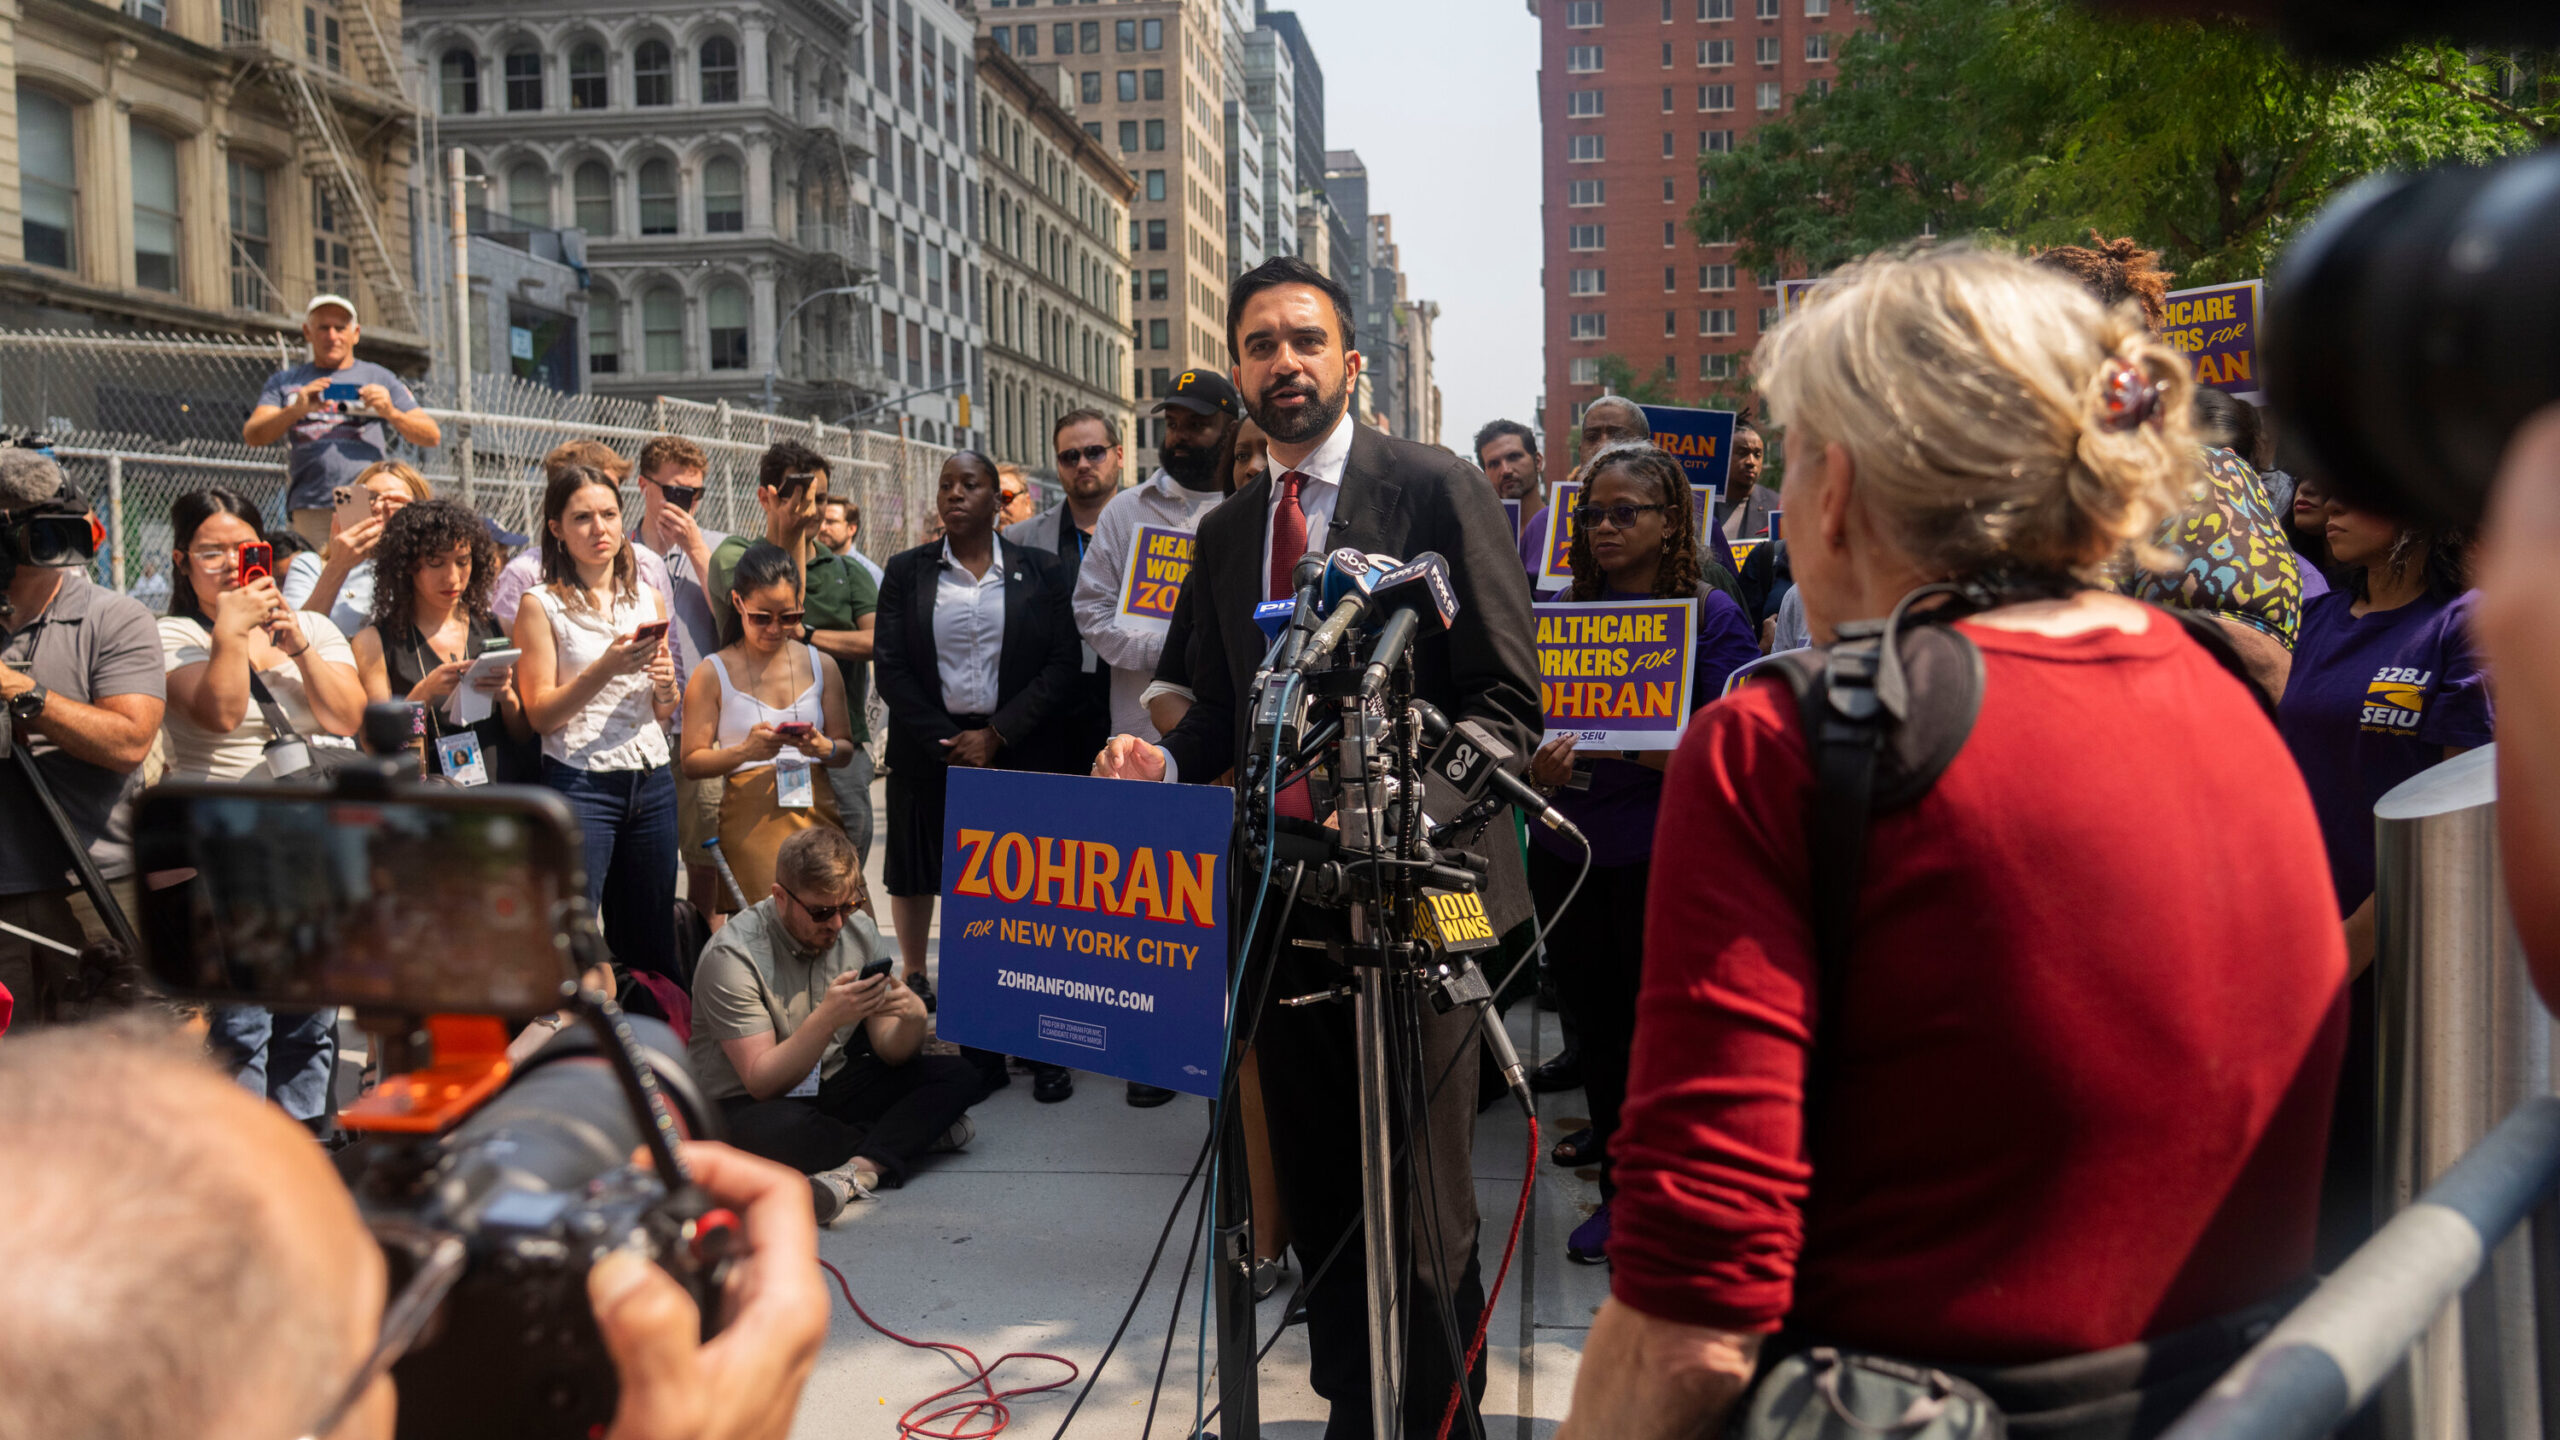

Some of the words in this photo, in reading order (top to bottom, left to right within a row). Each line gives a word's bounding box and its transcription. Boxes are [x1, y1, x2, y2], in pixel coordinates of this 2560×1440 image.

[2162, 295, 2236, 328] HCARE
[2207, 323, 2247, 348] FOR
[1177, 372, 1196, 391] P
[1653, 432, 1717, 457] RAN
[1684, 460, 1709, 469] CITY
[1337, 550, 1370, 573] abc
[1534, 614, 1668, 643] ALTHCARE
[1538, 648, 1629, 677] RKERS
[1631, 648, 1677, 673] FOR
[2372, 667, 2432, 685] 32BJ
[1541, 681, 1676, 718] HRAN
[2359, 707, 2421, 728] SEIU
[1456, 744, 1480, 768] 2
[953, 828, 1219, 928] ZOHRAN
[1429, 891, 1484, 921] 1010
[1438, 915, 1494, 943] WINS
[963, 919, 994, 938] FOR
[1000, 918, 1056, 948] NEW
[1062, 926, 1131, 960] YORK
[1137, 938, 1200, 970] CITY
[998, 969, 1154, 1013] ZOHRANFORNYC.COM
